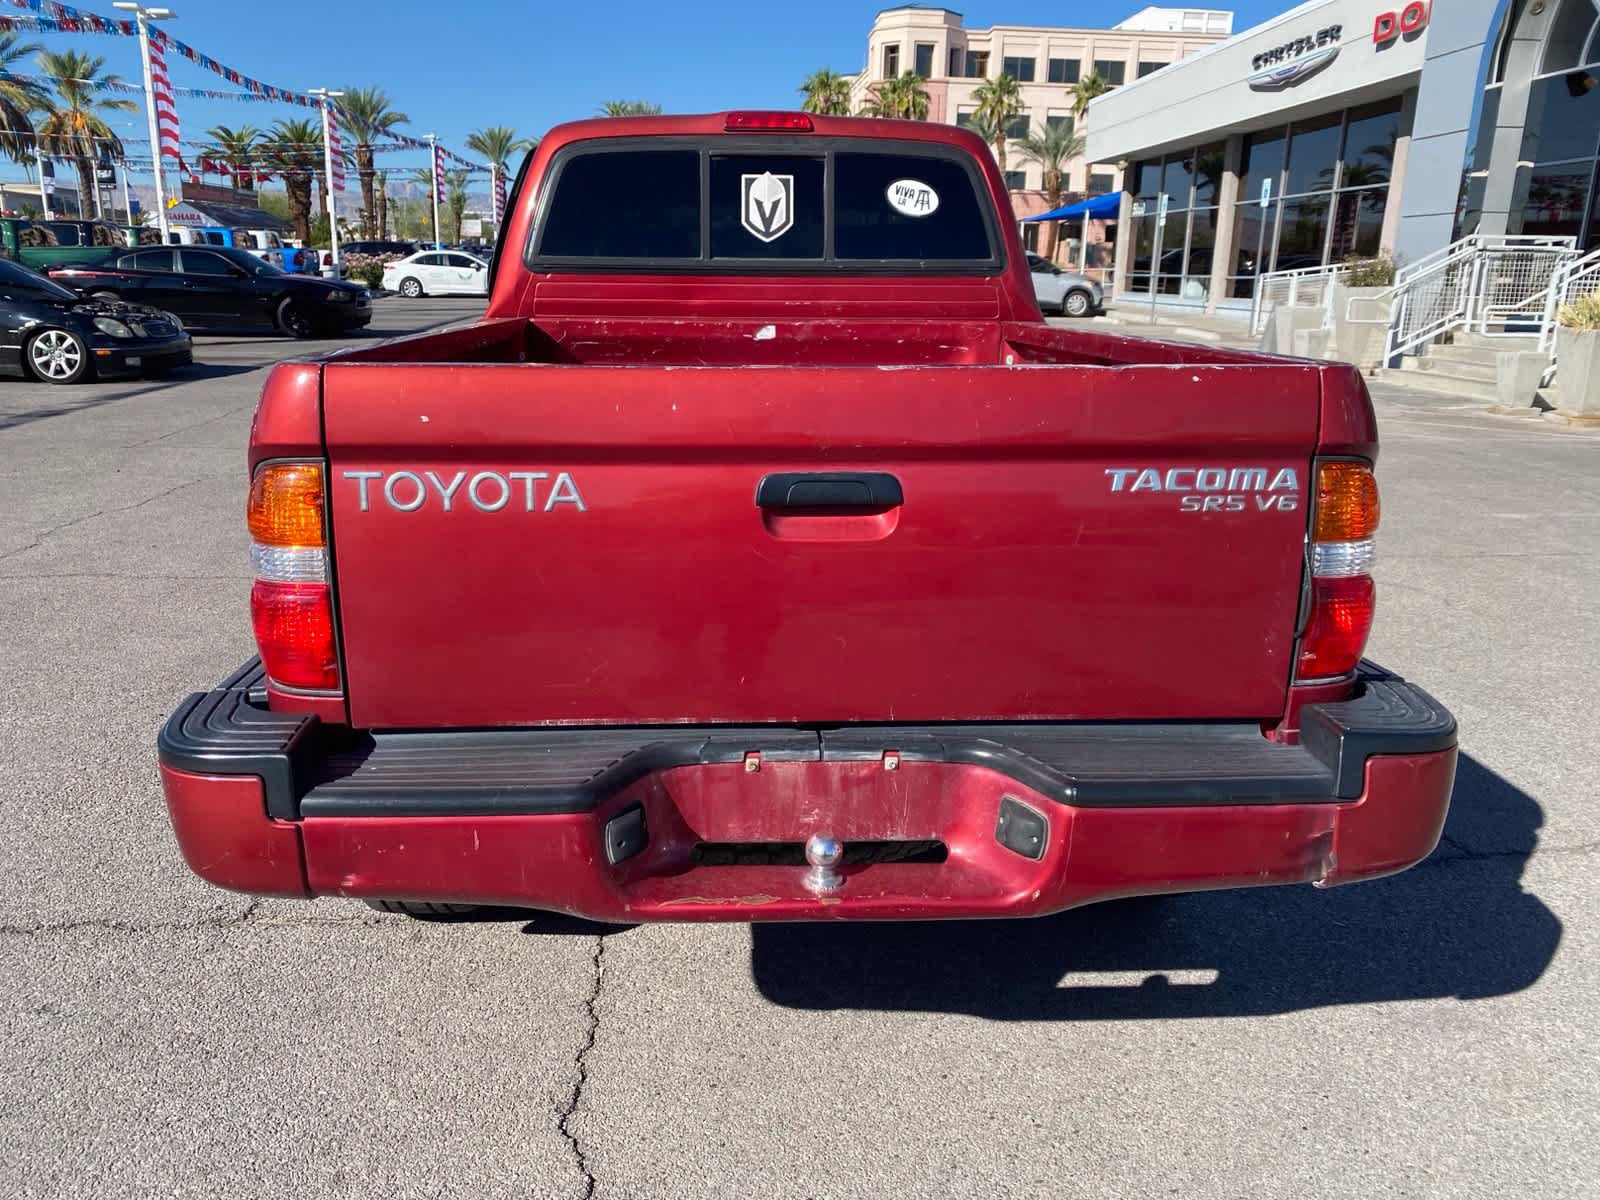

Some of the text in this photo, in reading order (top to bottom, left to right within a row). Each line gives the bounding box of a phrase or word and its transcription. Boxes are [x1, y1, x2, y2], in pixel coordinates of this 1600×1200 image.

[1372, 0, 1431, 43] DO
[1252, 24, 1343, 70] CHRYSLER
[896, 185, 915, 199] VIVA
[343, 471, 587, 512] TOYOTA
[1104, 468, 1299, 492] TACOMA
[1180, 495, 1298, 512] SR5 V6
